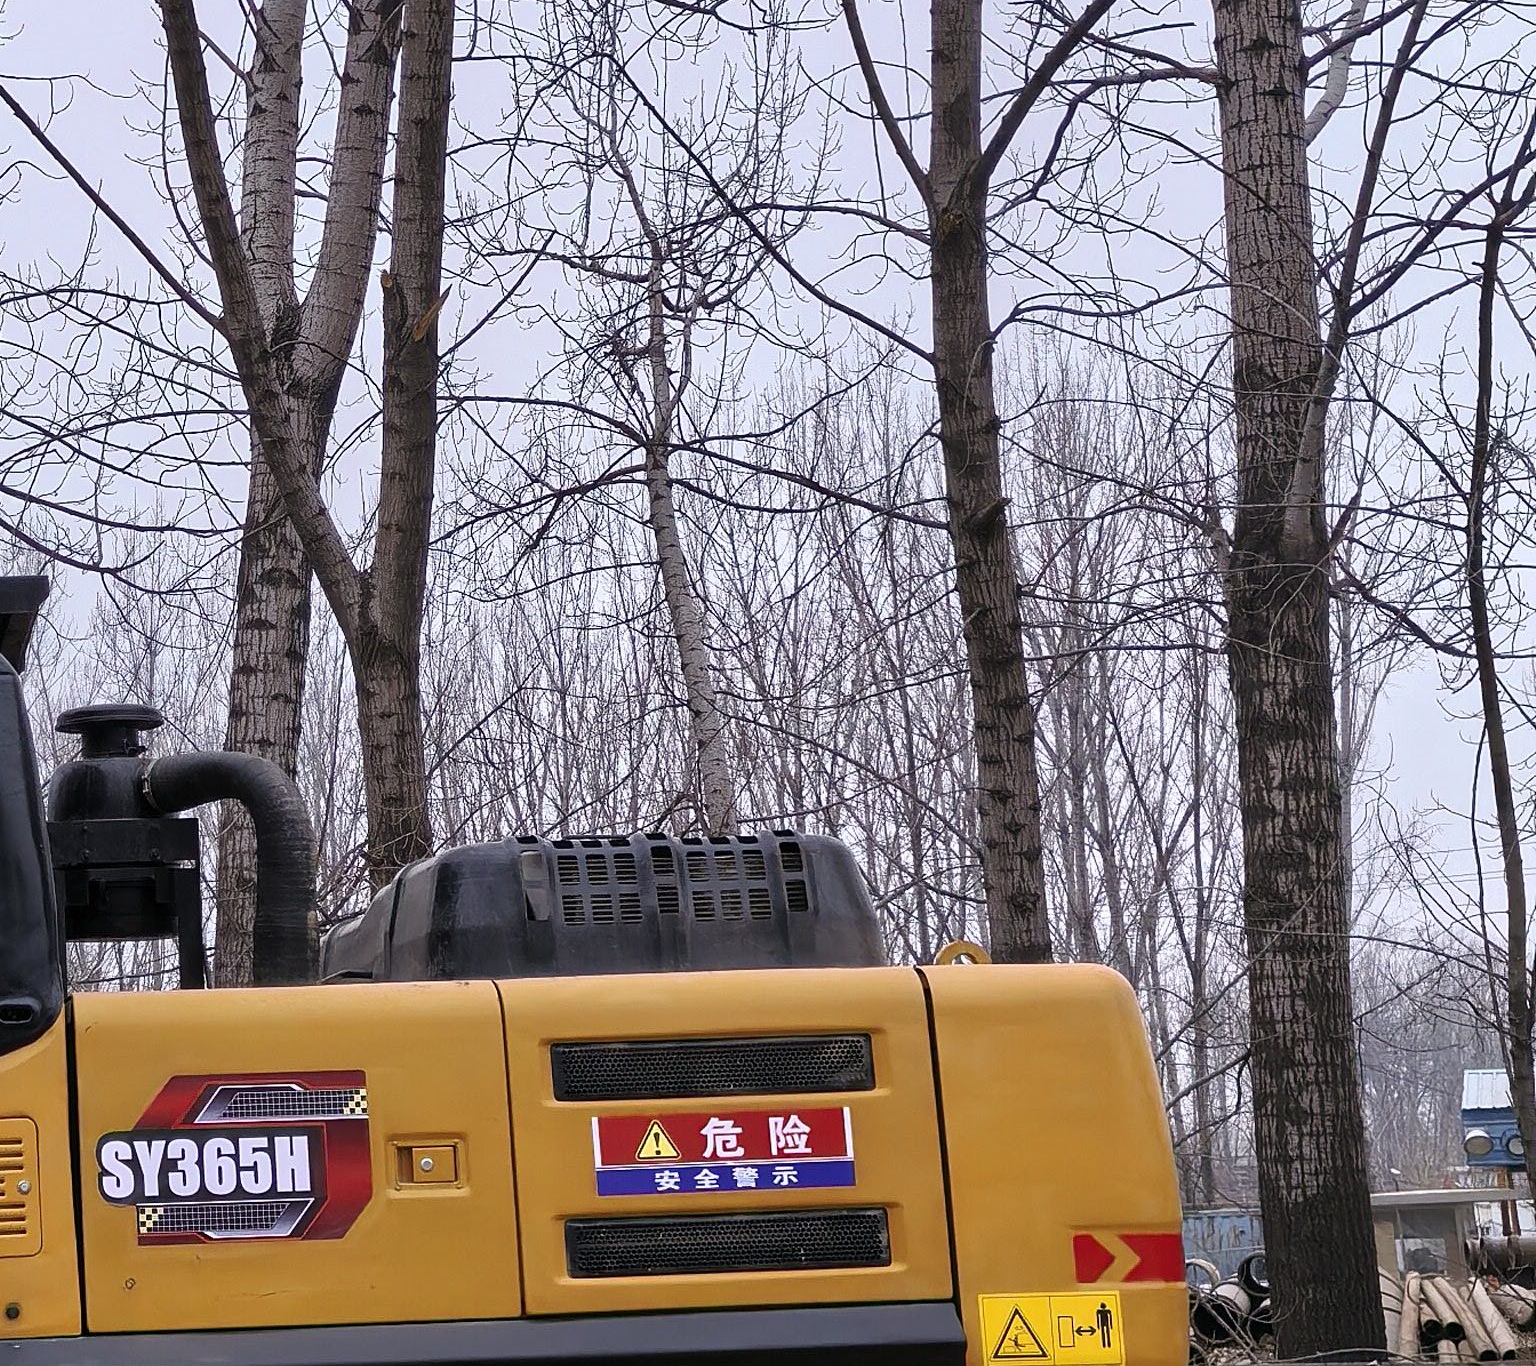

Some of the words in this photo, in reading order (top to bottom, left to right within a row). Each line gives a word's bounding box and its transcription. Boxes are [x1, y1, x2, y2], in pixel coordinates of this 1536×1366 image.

[699, 1114, 812, 1158] 危险
[101, 1135, 311, 1198] SY365H
[654, 1166, 798, 1191] 安全警示
